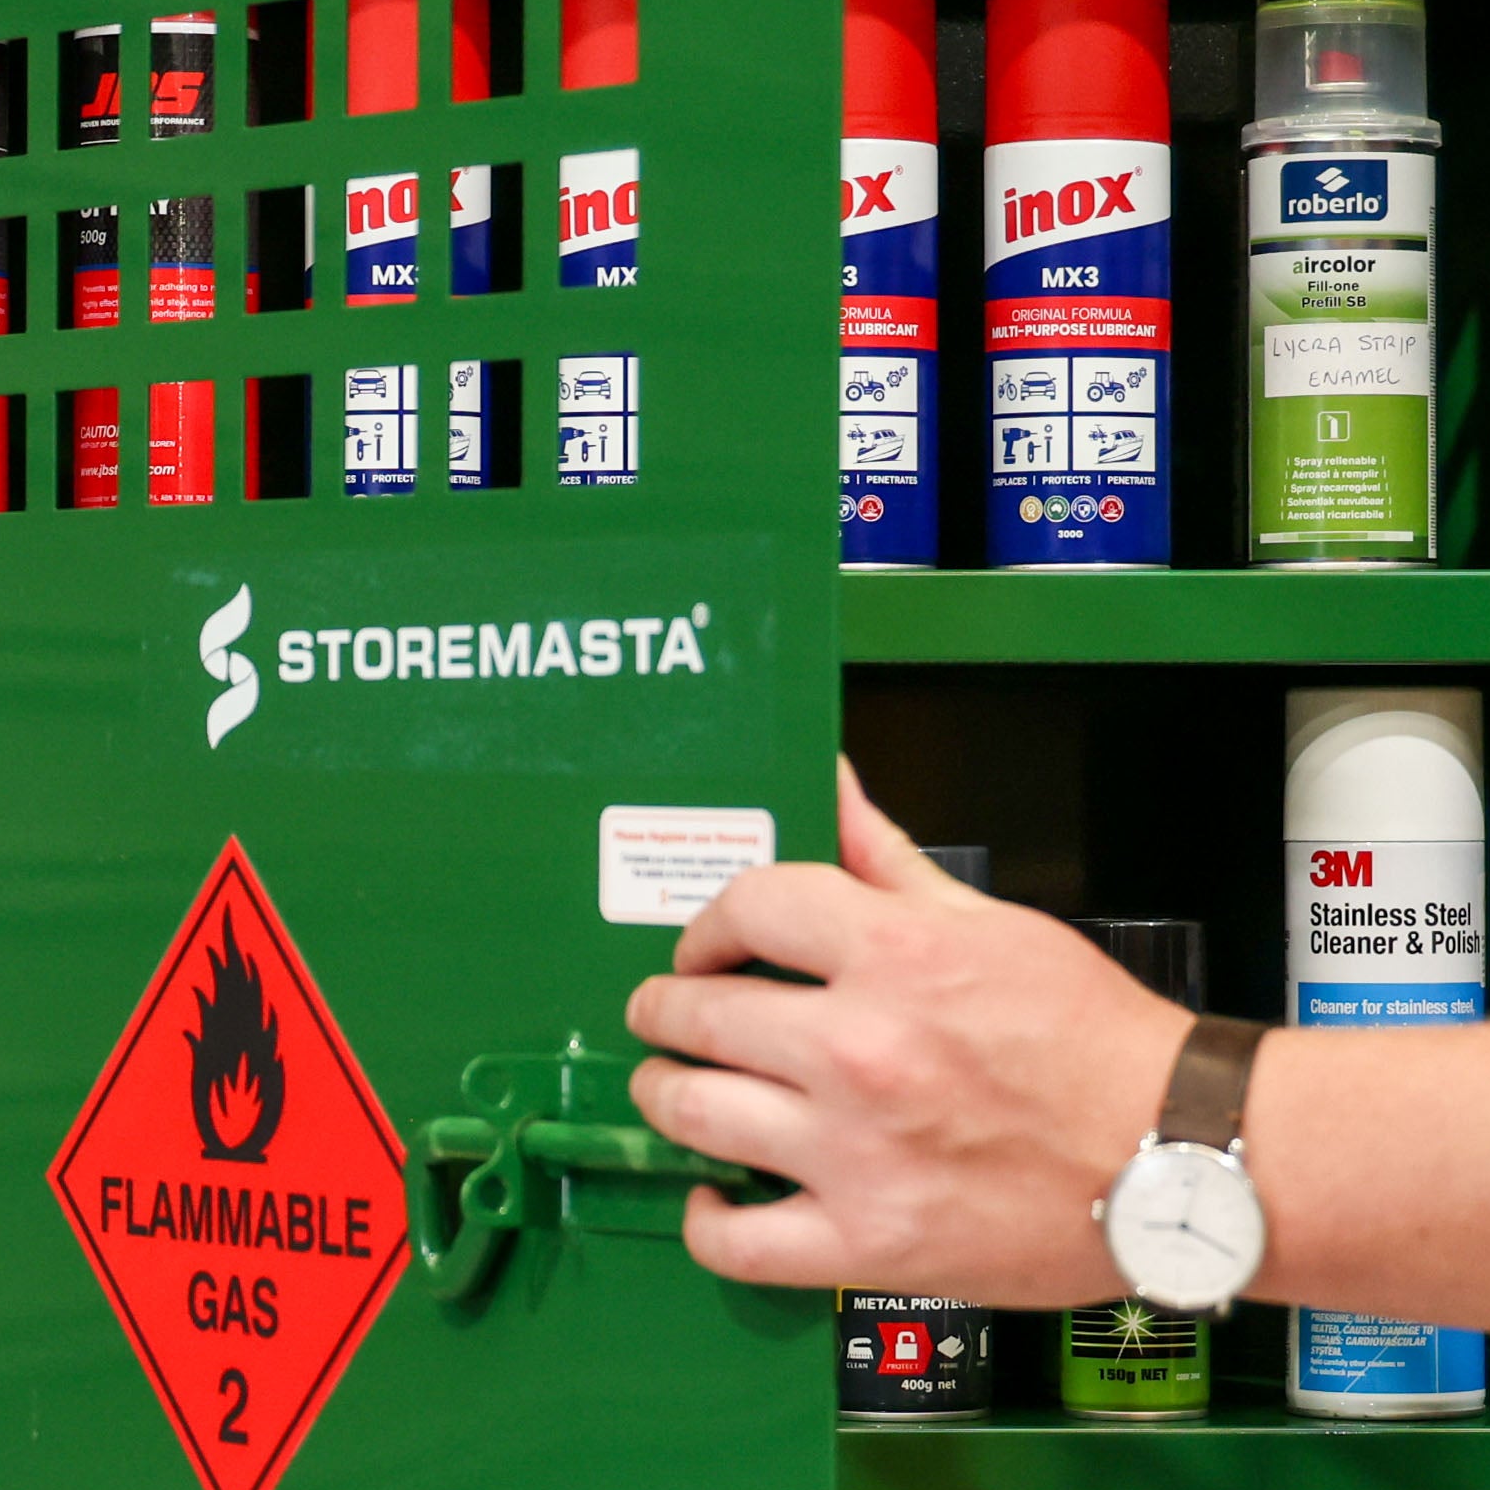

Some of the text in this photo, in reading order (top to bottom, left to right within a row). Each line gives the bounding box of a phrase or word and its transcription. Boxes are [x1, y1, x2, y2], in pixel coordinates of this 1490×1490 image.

[1004, 172, 1135, 244] inox
[1288, 194, 1379, 215] roberlo
[81, 230, 106, 245] 500g
[1293, 256, 1376, 274] aircolor
[1042, 266, 1099, 288] MX3
[1308, 281, 1359, 292] Fill-one
[1302, 296, 1366, 308] Prefill SB
[1012, 307, 1132, 322] ORIGINAL FORMULA
[848, 322, 919, 337] LUBRICANT
[992, 324, 1156, 339] MULTI-PURPOSE LUBRICANT
[1273, 337, 1341, 359] LYCRA
[1294, 456, 1376, 468] Spray rellenable
[866, 474, 918, 485] PENETRATES
[1042, 475, 1091, 485] PROTECTS
[1107, 476, 1156, 485] PENETRATES
[1292, 469, 1330, 480] Aérosol
[1342, 470, 1379, 480] remplir
[1290, 484, 1317, 494] Spray
[1287, 510, 1325, 520] Aerosol
[1058, 530, 1083, 538] 300G
[278, 617, 705, 682] STOREMASTA
[1310, 850, 1373, 887] 3M
[1310, 902, 1471, 927] Stainless Steel
[1311, 930, 1398, 955] Cleaner
[1406, 930, 1423, 955] &
[1432, 930, 1480, 954] Polish
[1310, 999, 1358, 1015] Cleaner
[1362, 999, 1382, 1015] for
[1386, 999, 1447, 1015] stainless
[101, 1176, 372, 1259] FLAMMABLE
[188, 1270, 278, 1339] GAS
[854, 1297, 907, 1310] METAL
[1422, 1326, 1433, 1335] TO
[1099, 1368, 1135, 1384] 150g
[1141, 1368, 1168, 1381] NET
[901, 1379, 956, 1392] 400g net
[218, 1368, 249, 1446] 2
